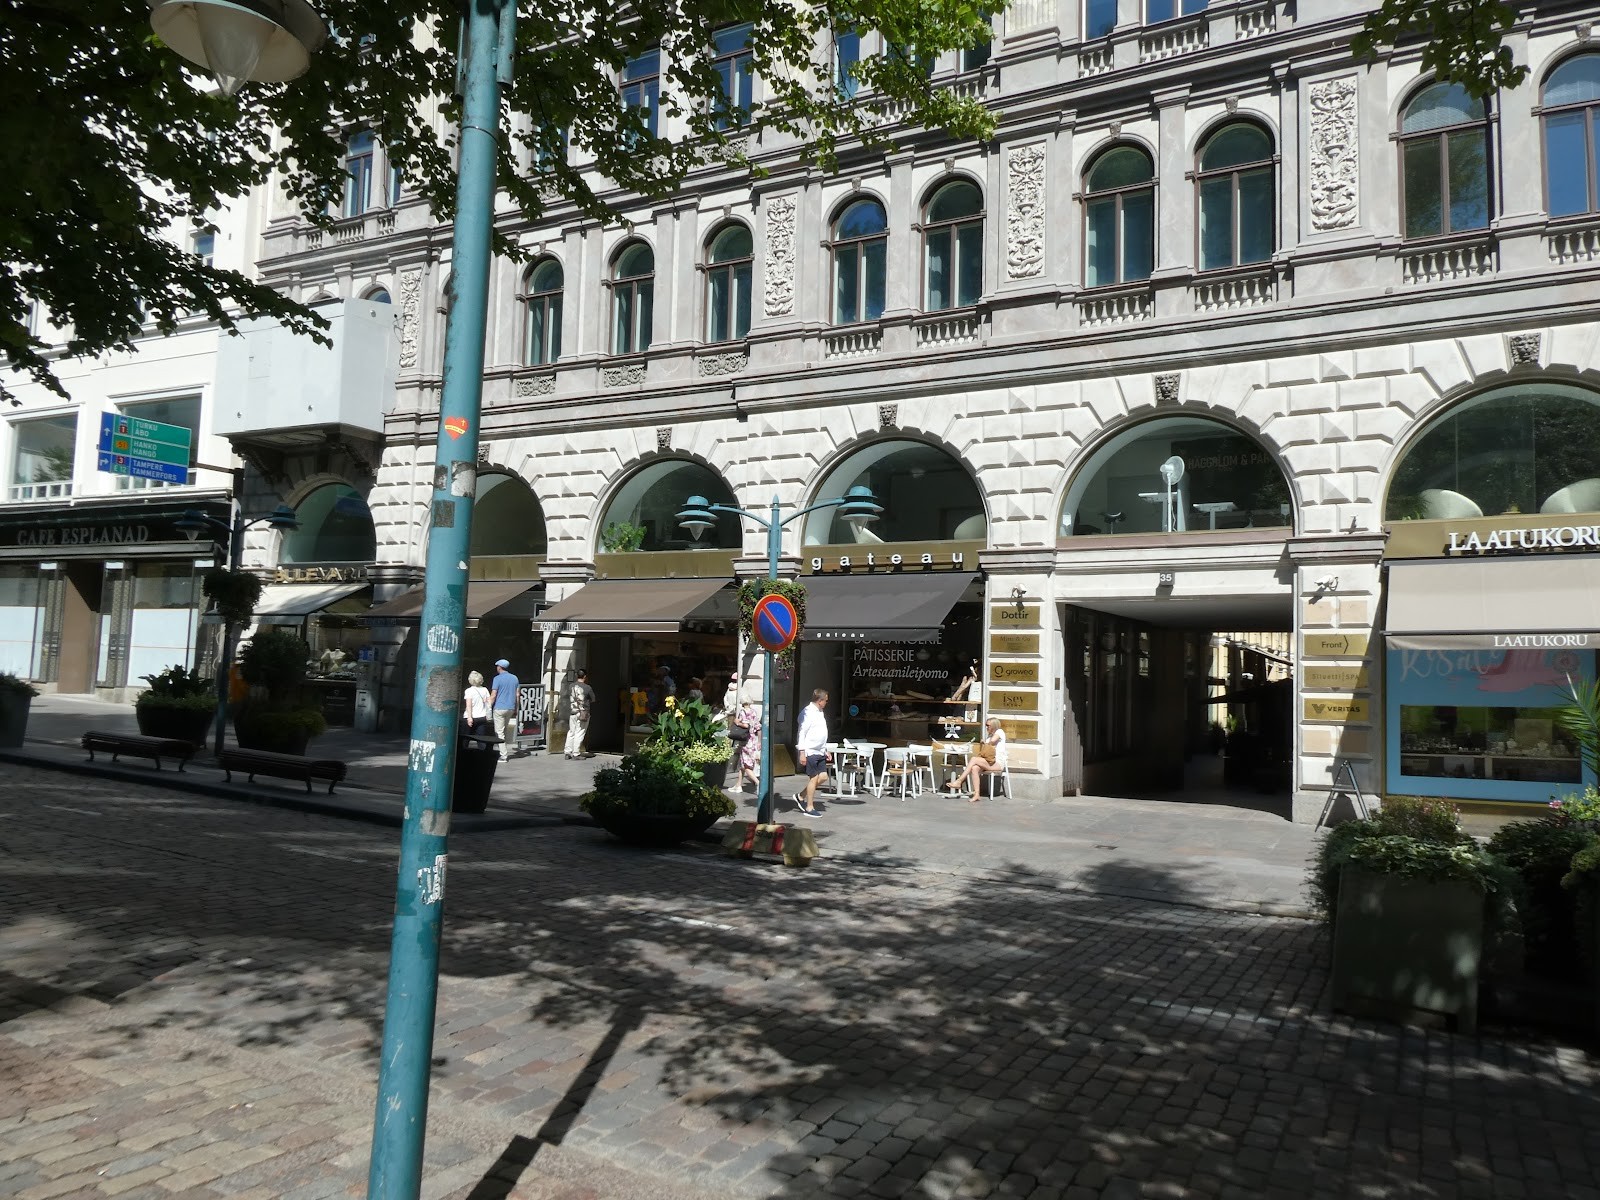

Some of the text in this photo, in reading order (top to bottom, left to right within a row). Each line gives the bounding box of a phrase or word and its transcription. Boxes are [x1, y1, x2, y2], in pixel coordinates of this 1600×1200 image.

[135, 421, 158, 431] TURKU
[133, 440, 157, 451] HANKO
[133, 459, 164, 471] TAMPERE
[132, 467, 177, 481] TAMMERFORS
[61, 525, 149, 544] ESPLANAD
[811, 552, 963, 571] gateau
[1160, 573, 1172, 582] 35
[1001, 610, 1029, 619] Dottir
[1321, 641, 1342, 649] Front
[1494, 635, 1588, 647] LAATUKORU
[853, 646, 915, 662] PÂTISSERIE
[852, 664, 949, 681] Artesaanileipomo
[520, 687, 543, 700] SOU
[520, 700, 542, 711] VEN
[519, 710, 542, 721] IRS
